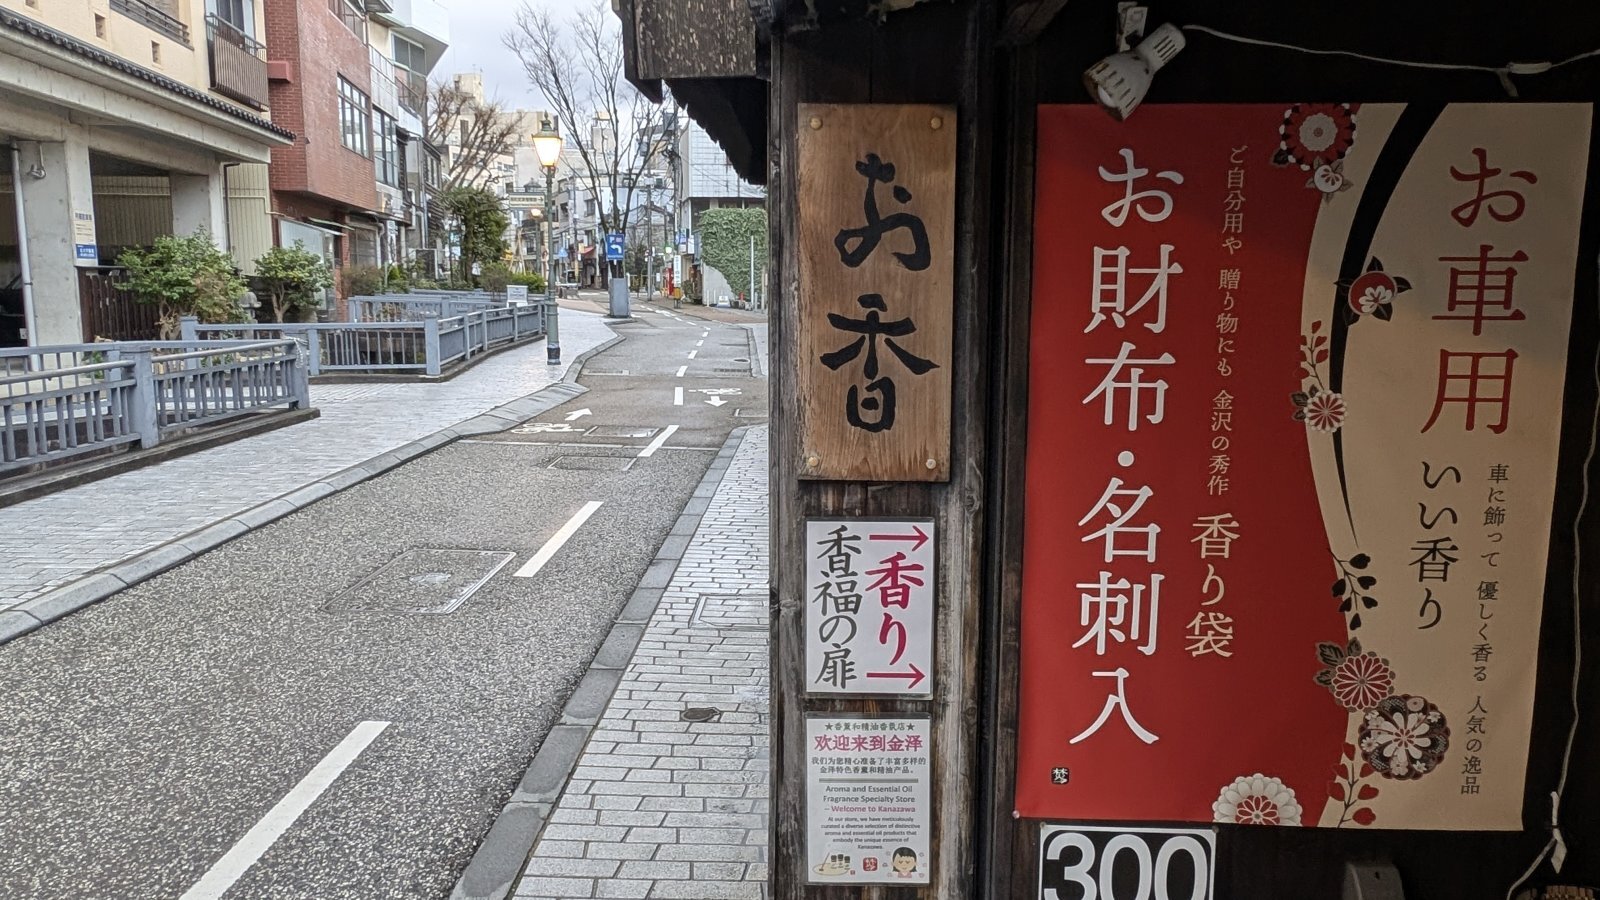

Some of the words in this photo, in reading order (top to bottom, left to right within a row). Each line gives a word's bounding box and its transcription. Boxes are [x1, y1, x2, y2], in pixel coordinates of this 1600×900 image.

[1222, 145, 1249, 255] ご自分用や
[819, 152, 941, 433] お香
[1214, 268, 1241, 377] 贈り物にも
[1420, 147, 1538, 435] お車用
[1069, 147, 1185, 745] お財布・名刺入
[1206, 389, 1235, 496] 金沢の秀作
[1408, 460, 1462, 630] いい香り
[1480, 463, 1510, 568] 車に飾って
[812, 524, 863, 690] 香福の扉
[864, 551, 925, 666] 香り
[1184, 512, 1241, 658] 香り袋
[1471, 580, 1499, 682] 優しく香る
[814, 734, 923, 752] 欢迎来到金泽
[825, 785, 851, 793] Aroma
[852, 785, 867, 793] and
[868, 785, 901, 793] Essential
[901, 785, 913, 793] Oil
[1460, 695, 1487, 795] 人気の逸品
[823, 795, 859, 804] Fragrance
[860, 795, 895, 804] Specialty
[895, 795, 916, 803] Store
[831, 805, 867, 813] Welcome
[878, 805, 916, 813] Kanazawa
[1043, 832, 1208, 900] 300
